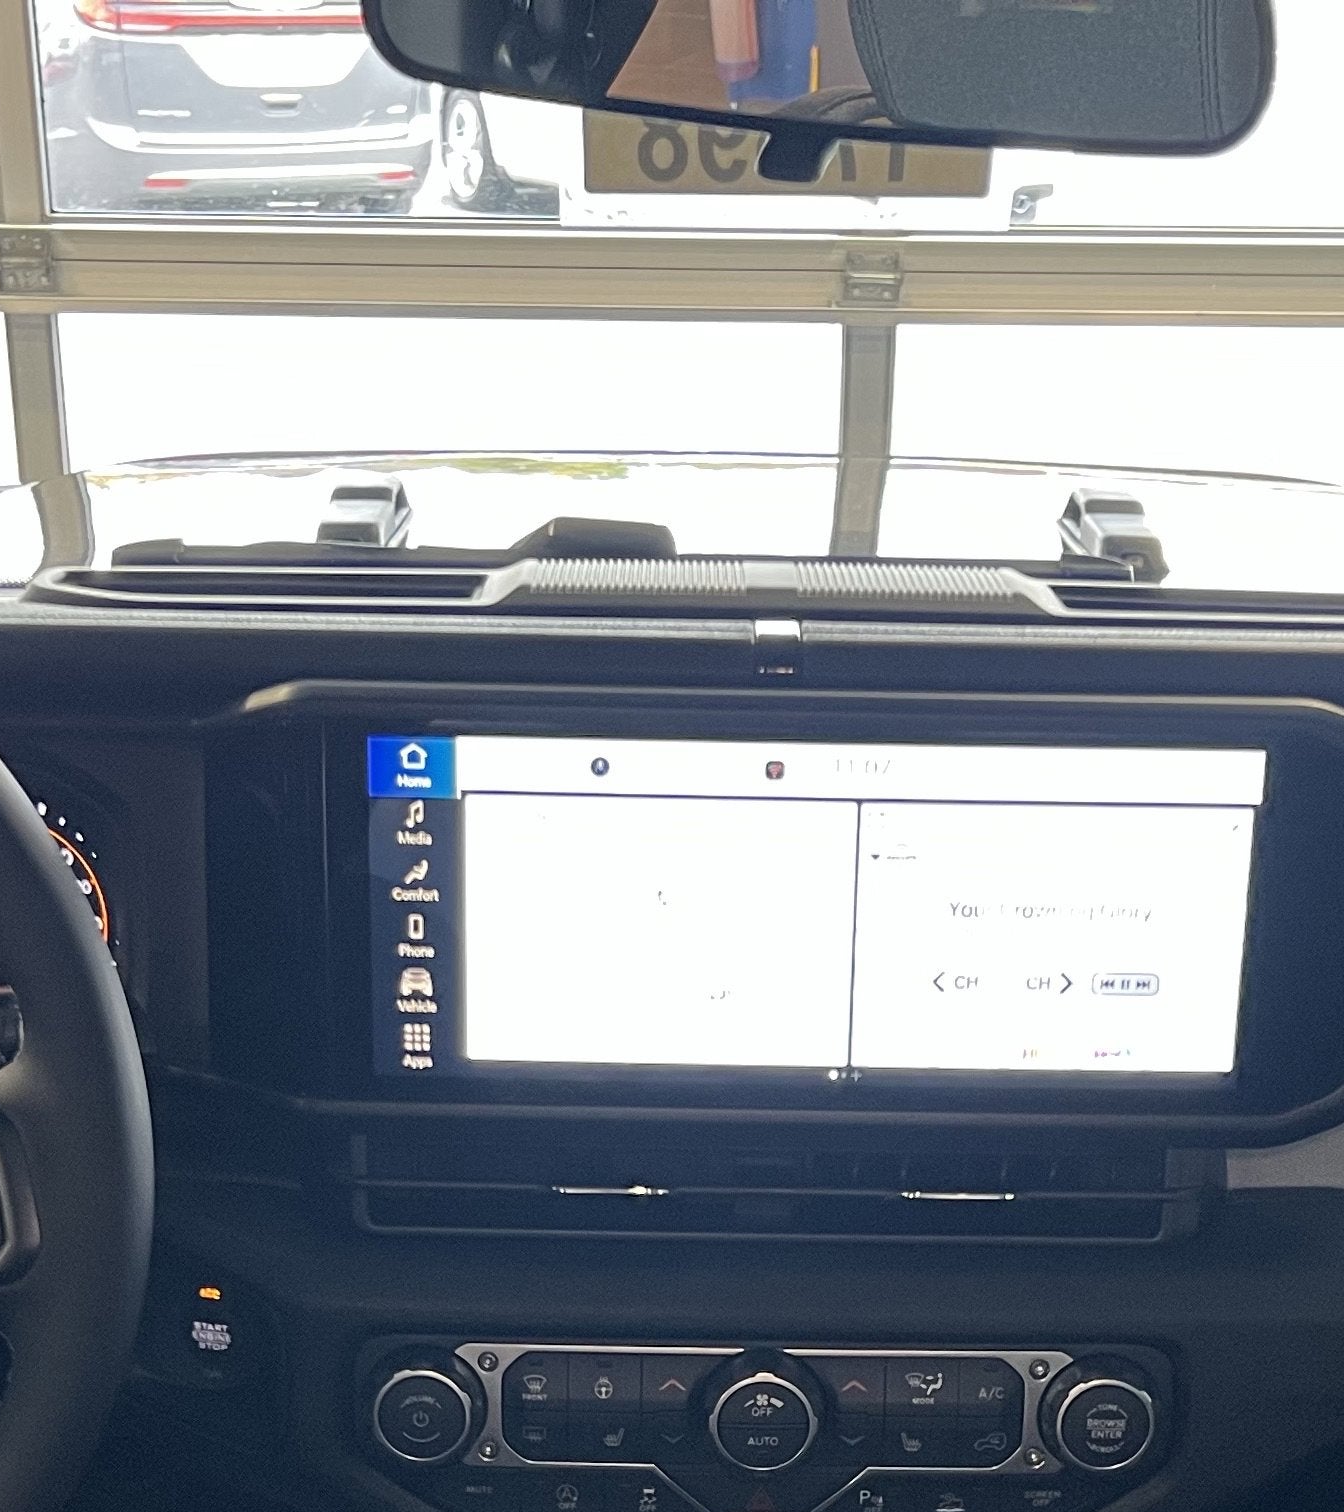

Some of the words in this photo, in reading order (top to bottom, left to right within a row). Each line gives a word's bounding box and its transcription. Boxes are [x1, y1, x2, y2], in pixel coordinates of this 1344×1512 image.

[396, 774, 432, 788] Home
[396, 830, 433, 846] Media
[391, 887, 440, 903] Comfort
[397, 943, 436, 959] Phone
[954, 975, 979, 990] CH
[1026, 975, 1051, 991] CH
[396, 998, 438, 1014] Vehicle
[401, 1054, 434, 1071] Apps
[193, 1320, 229, 1332] START
[521, 1392, 548, 1401] FRONT
[978, 1386, 1004, 1400] A/C
[751, 1407, 774, 1417] OFF
[747, 1436, 779, 1446] AUTO
[1090, 1430, 1123, 1439] ENTER
